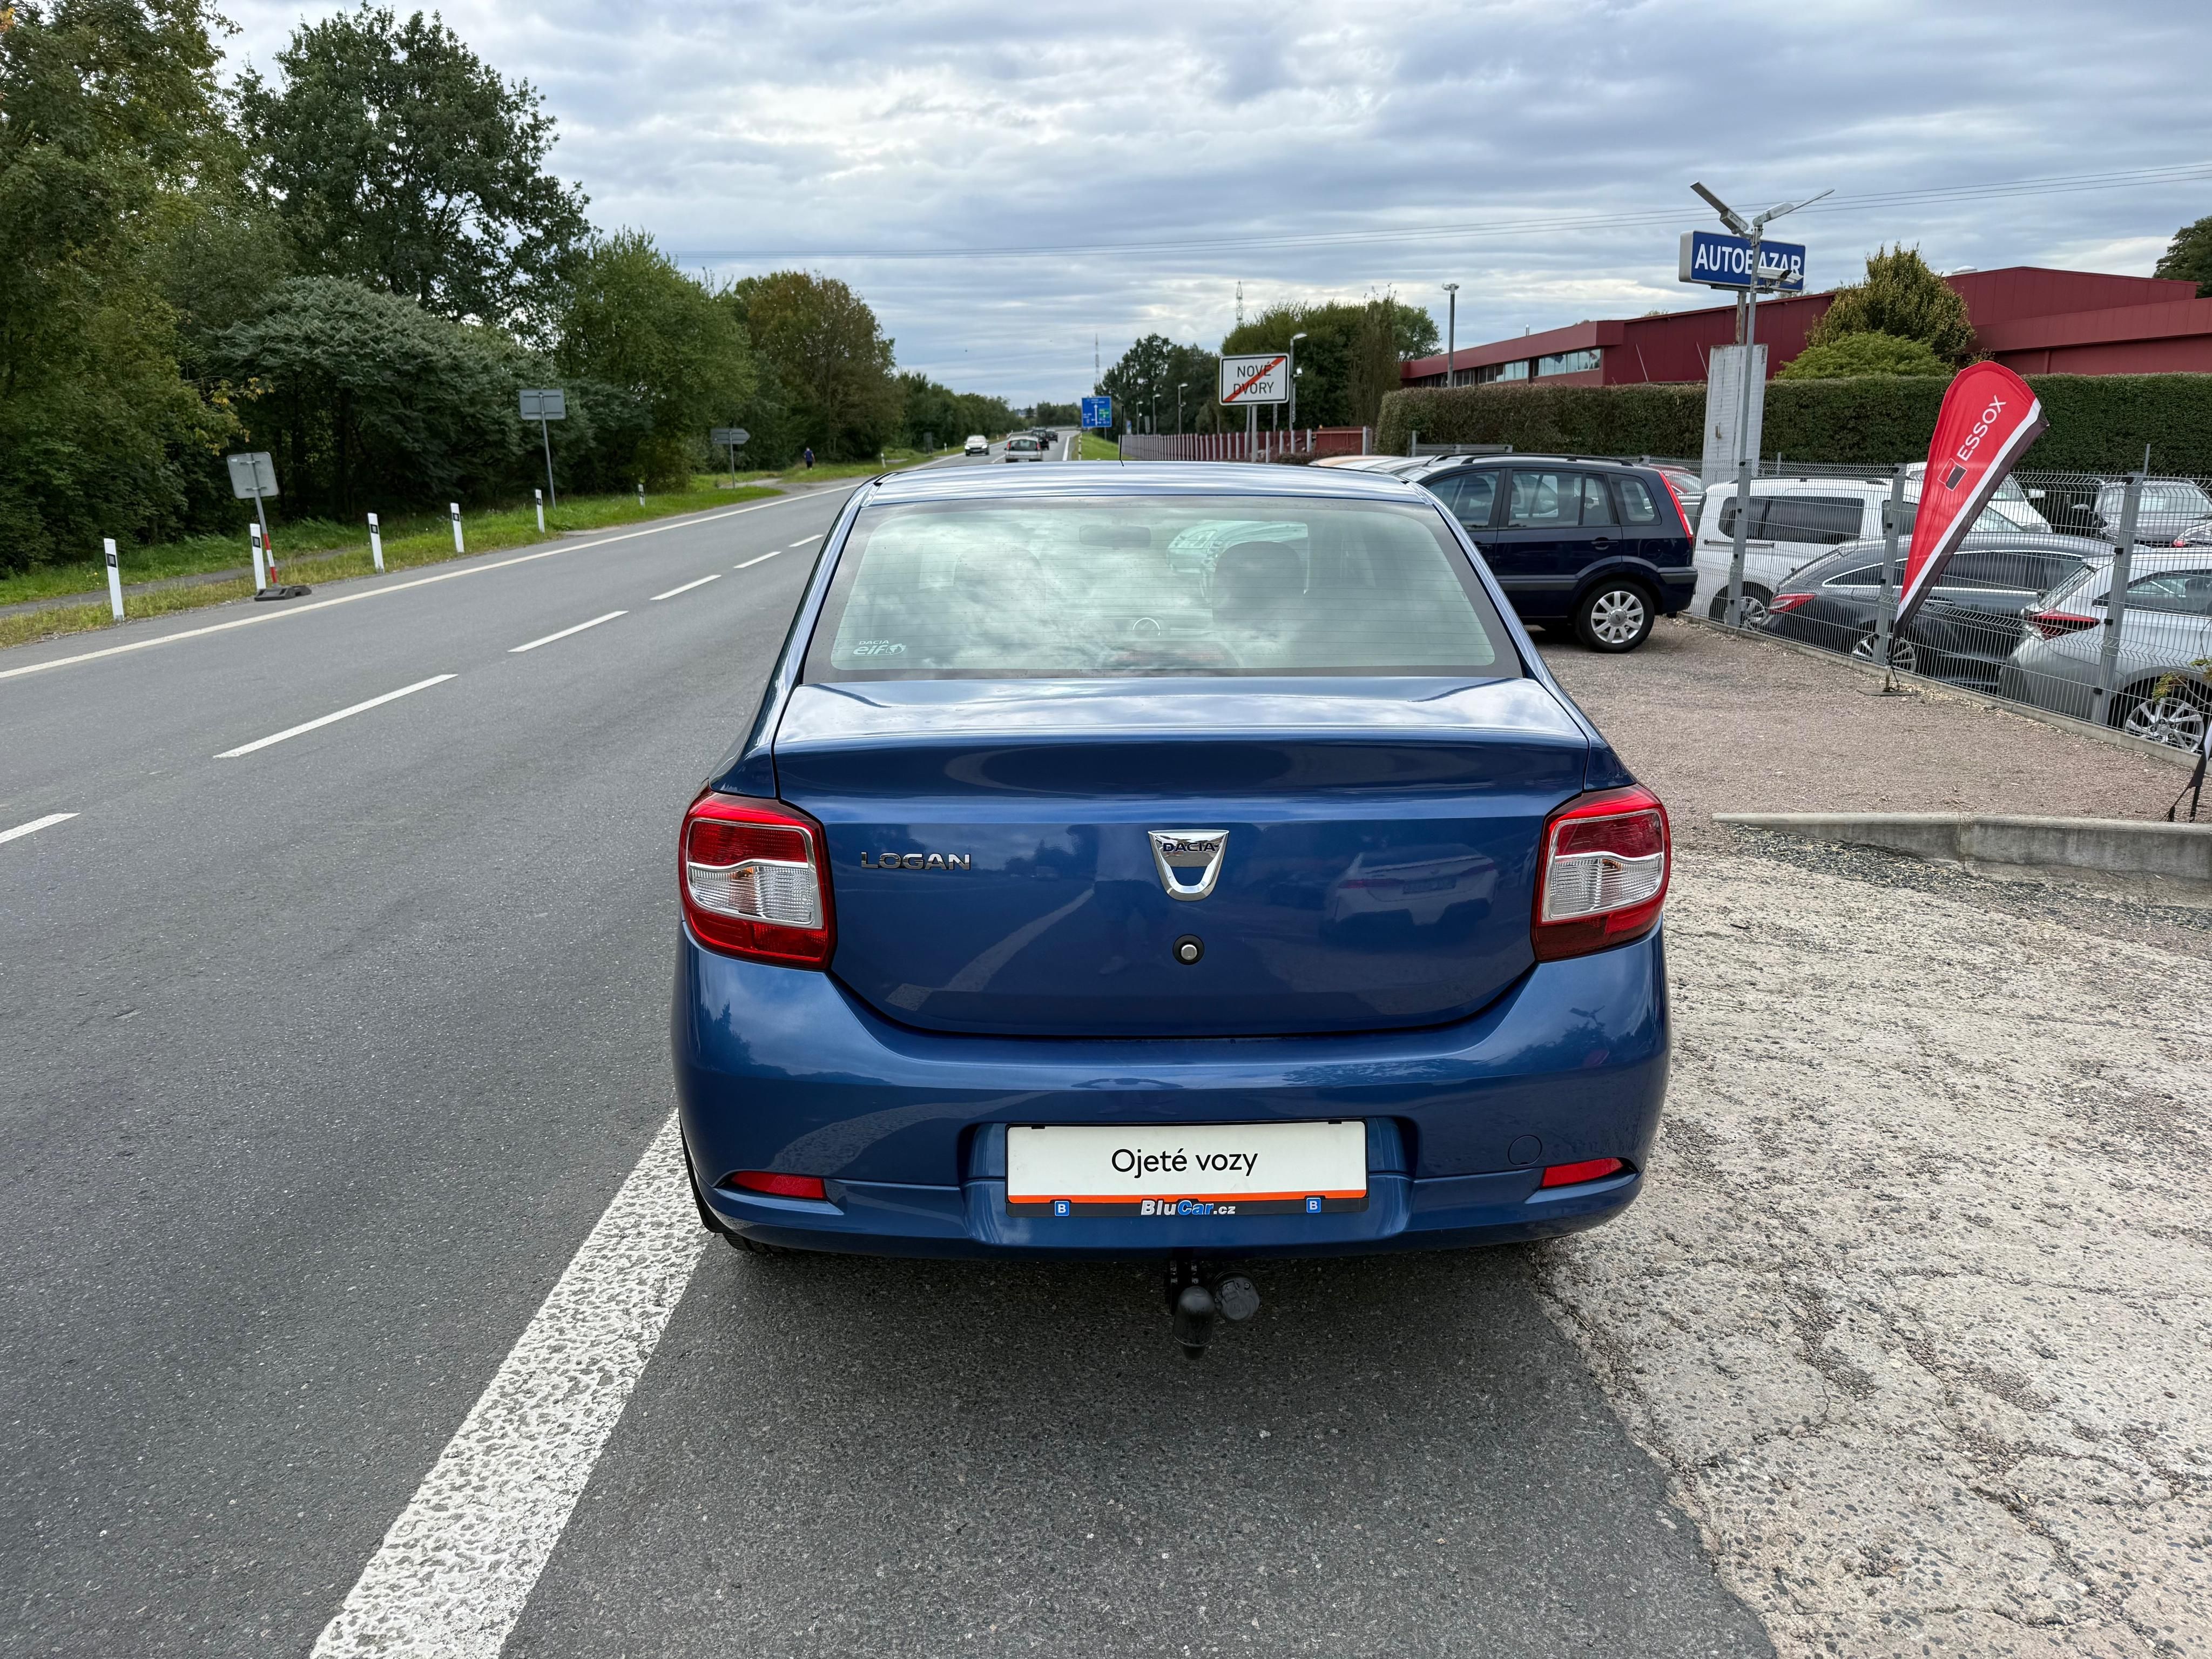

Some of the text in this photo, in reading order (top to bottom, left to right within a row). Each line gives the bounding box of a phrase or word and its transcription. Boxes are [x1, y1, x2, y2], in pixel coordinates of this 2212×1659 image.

[1237, 361, 1271, 377] NOVÉ
[1233, 381, 1274, 395] DVORY
[1957, 394, 2007, 461] ESSOX
[1163, 842, 1216, 852] DACIA
[861, 852, 970, 870] LOGAN
[1111, 1148, 1258, 1178] Ojeté vozy
[1058, 1204, 1067, 1213] B
[1141, 1199, 1236, 1215] BluCar.cz
[1310, 1201, 1318, 1210] B
